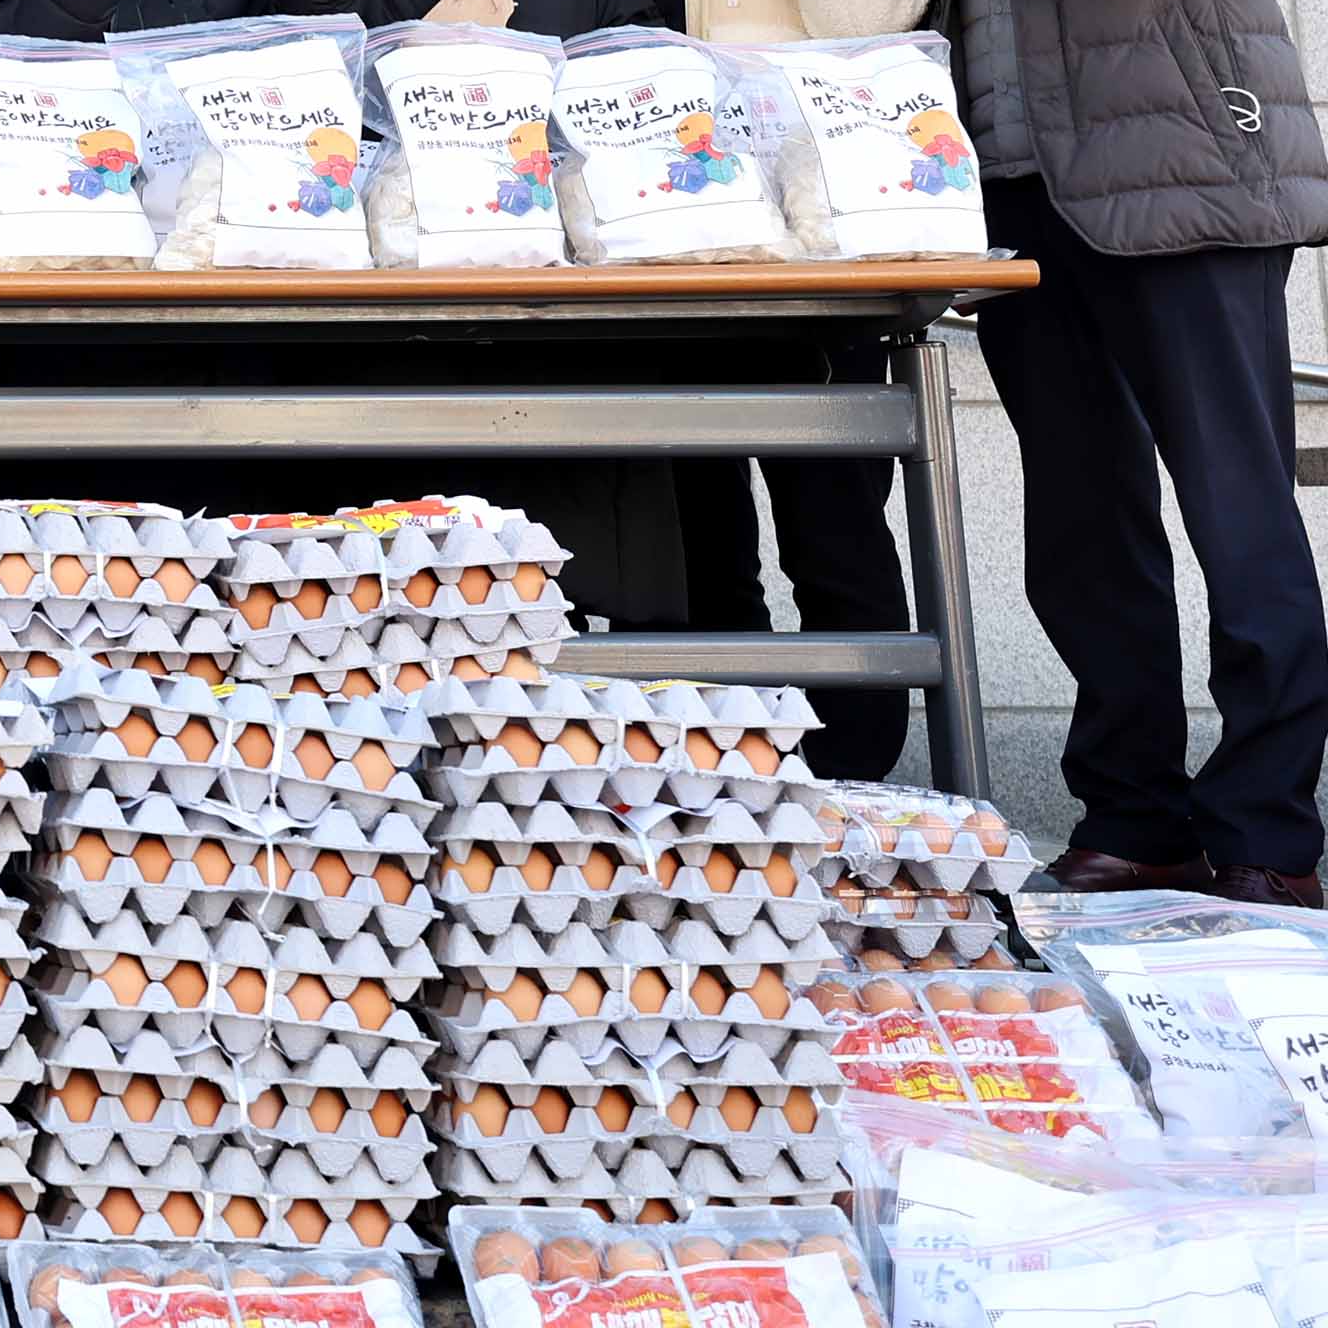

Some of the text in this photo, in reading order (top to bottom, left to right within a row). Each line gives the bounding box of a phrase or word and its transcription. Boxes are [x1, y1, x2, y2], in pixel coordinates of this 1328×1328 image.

[202, 89, 252, 107] 새해
[403, 86, 455, 106] 새해
[566, 98, 620, 115] 새해
